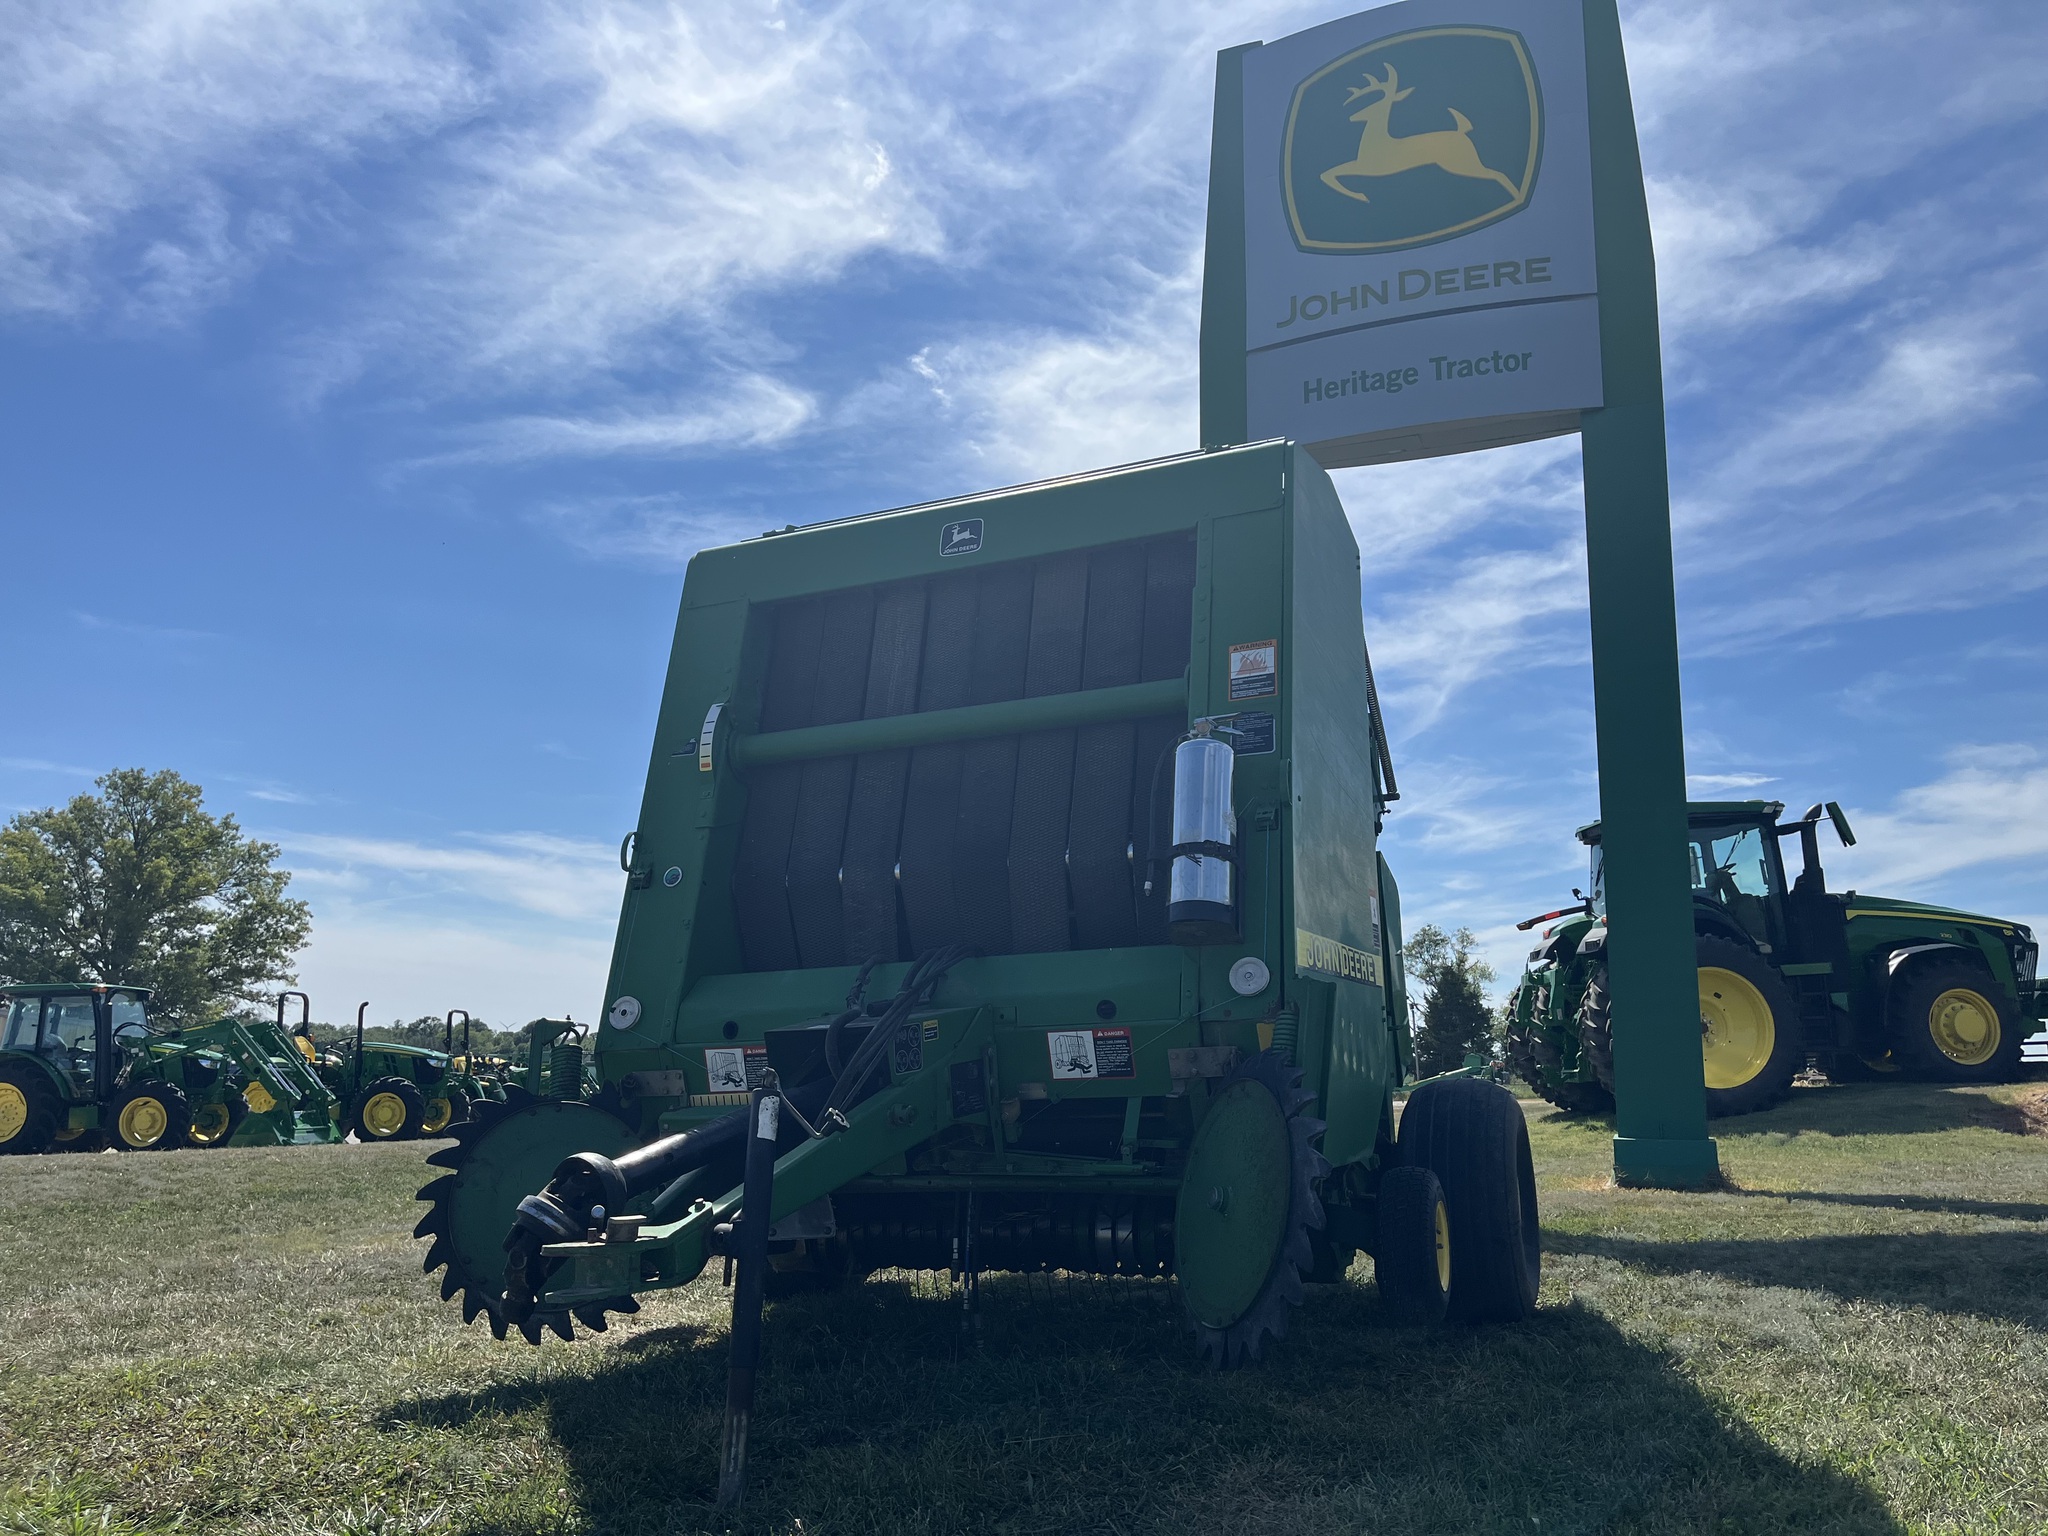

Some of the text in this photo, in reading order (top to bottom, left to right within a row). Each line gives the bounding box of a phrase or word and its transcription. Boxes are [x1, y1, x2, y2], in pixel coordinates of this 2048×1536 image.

[1276, 256, 1552, 329] JOHN DEERE
[1303, 350, 1533, 404] Heritage Tractor
[1239, 640, 1273, 650] WARNING
[1306, 935, 1340, 973] JOHN
[1341, 945, 1375, 982] DEERE
